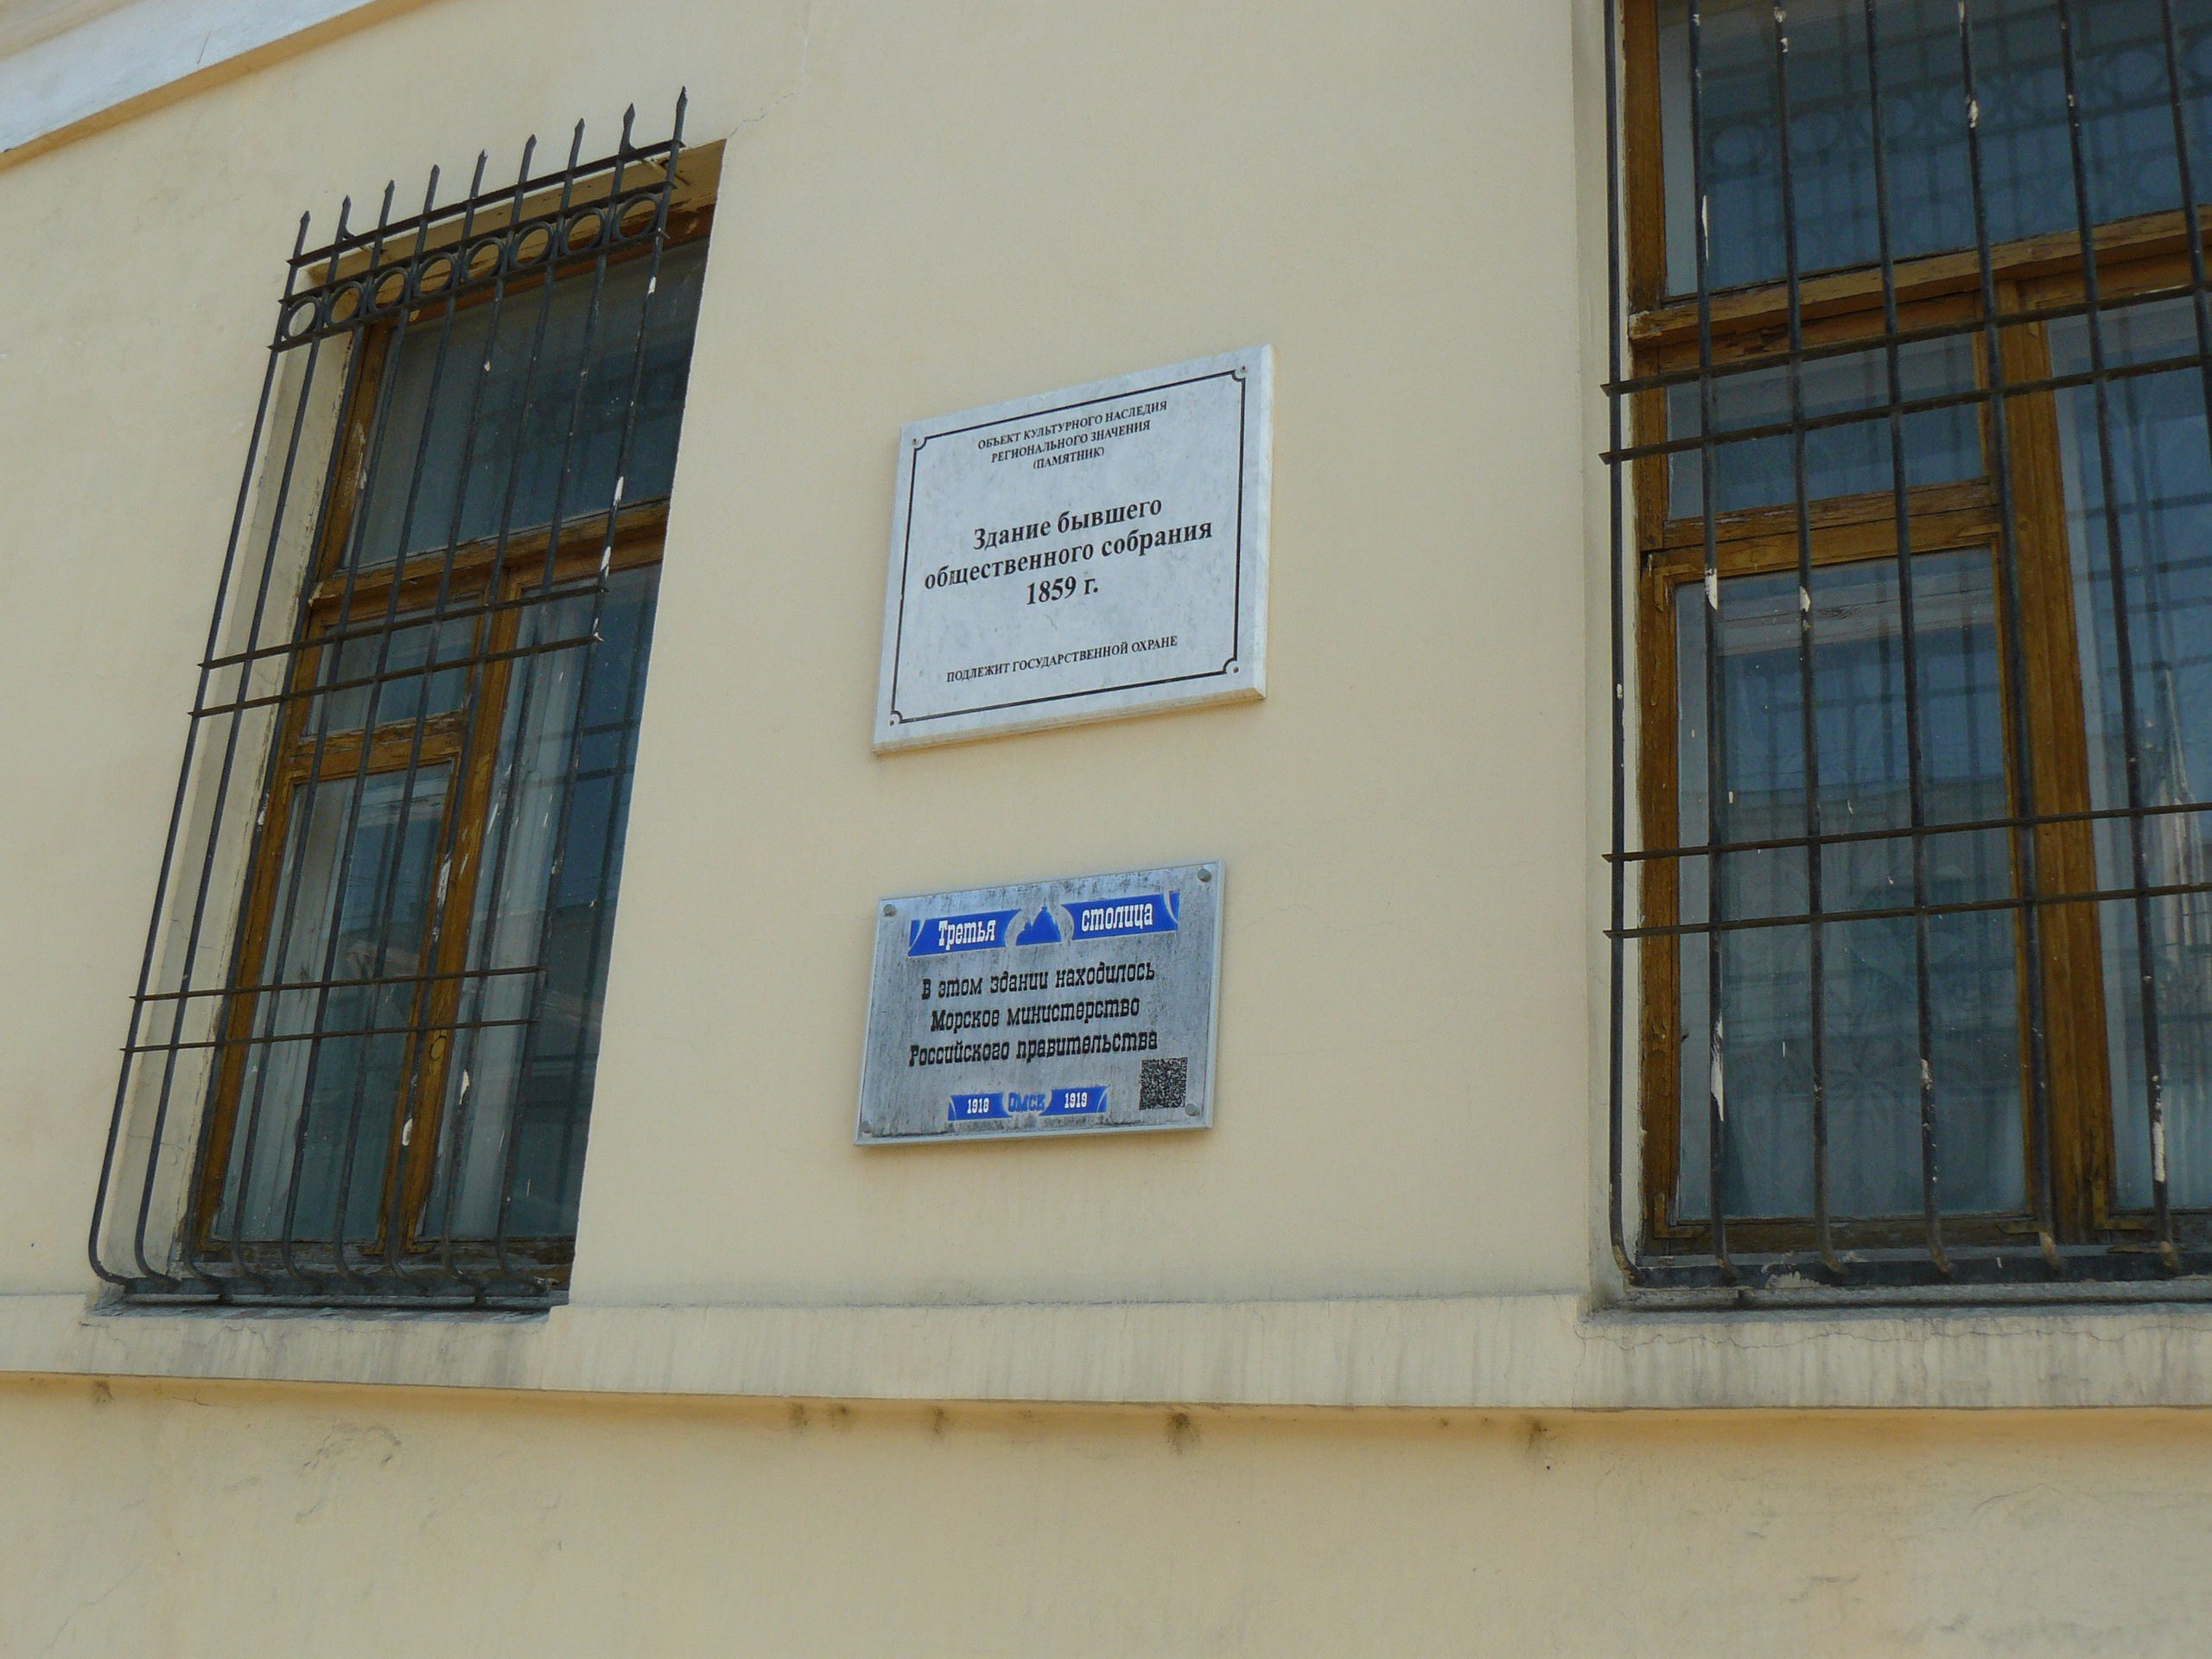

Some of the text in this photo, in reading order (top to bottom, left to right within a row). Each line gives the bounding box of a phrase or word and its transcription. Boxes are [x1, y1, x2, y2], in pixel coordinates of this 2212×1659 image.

[978, 401, 1167, 449] ОБЪЕКТ КУЛЬТУРНОГО НАСЛЕДИЯ
[991, 420, 1150, 463] РЕГИОНАЛЬНОГО ЗНАЧЕНИЯ
[1033, 447, 1104, 470] (ПАМЯТНИК)
[974, 499, 1162, 550] Здание бывшего
[925, 523, 1212, 589] общественного собрания
[1027, 576, 1098, 605] 1859 г.
[947, 636, 1177, 683] ПОДЛЕЖИТ ГОСУДАРСТВЕННОЙ ОХРАНЕ
[938, 902, 1154, 950] Третья столица
[922, 962, 1154, 1000] В этом здании находилось
[931, 997, 1140, 1033] Морское министерство
[909, 1030, 1157, 1067] Российского правительства
[967, 1097, 989, 1114] 1918
[1065, 1091, 1088, 1109] 1919
